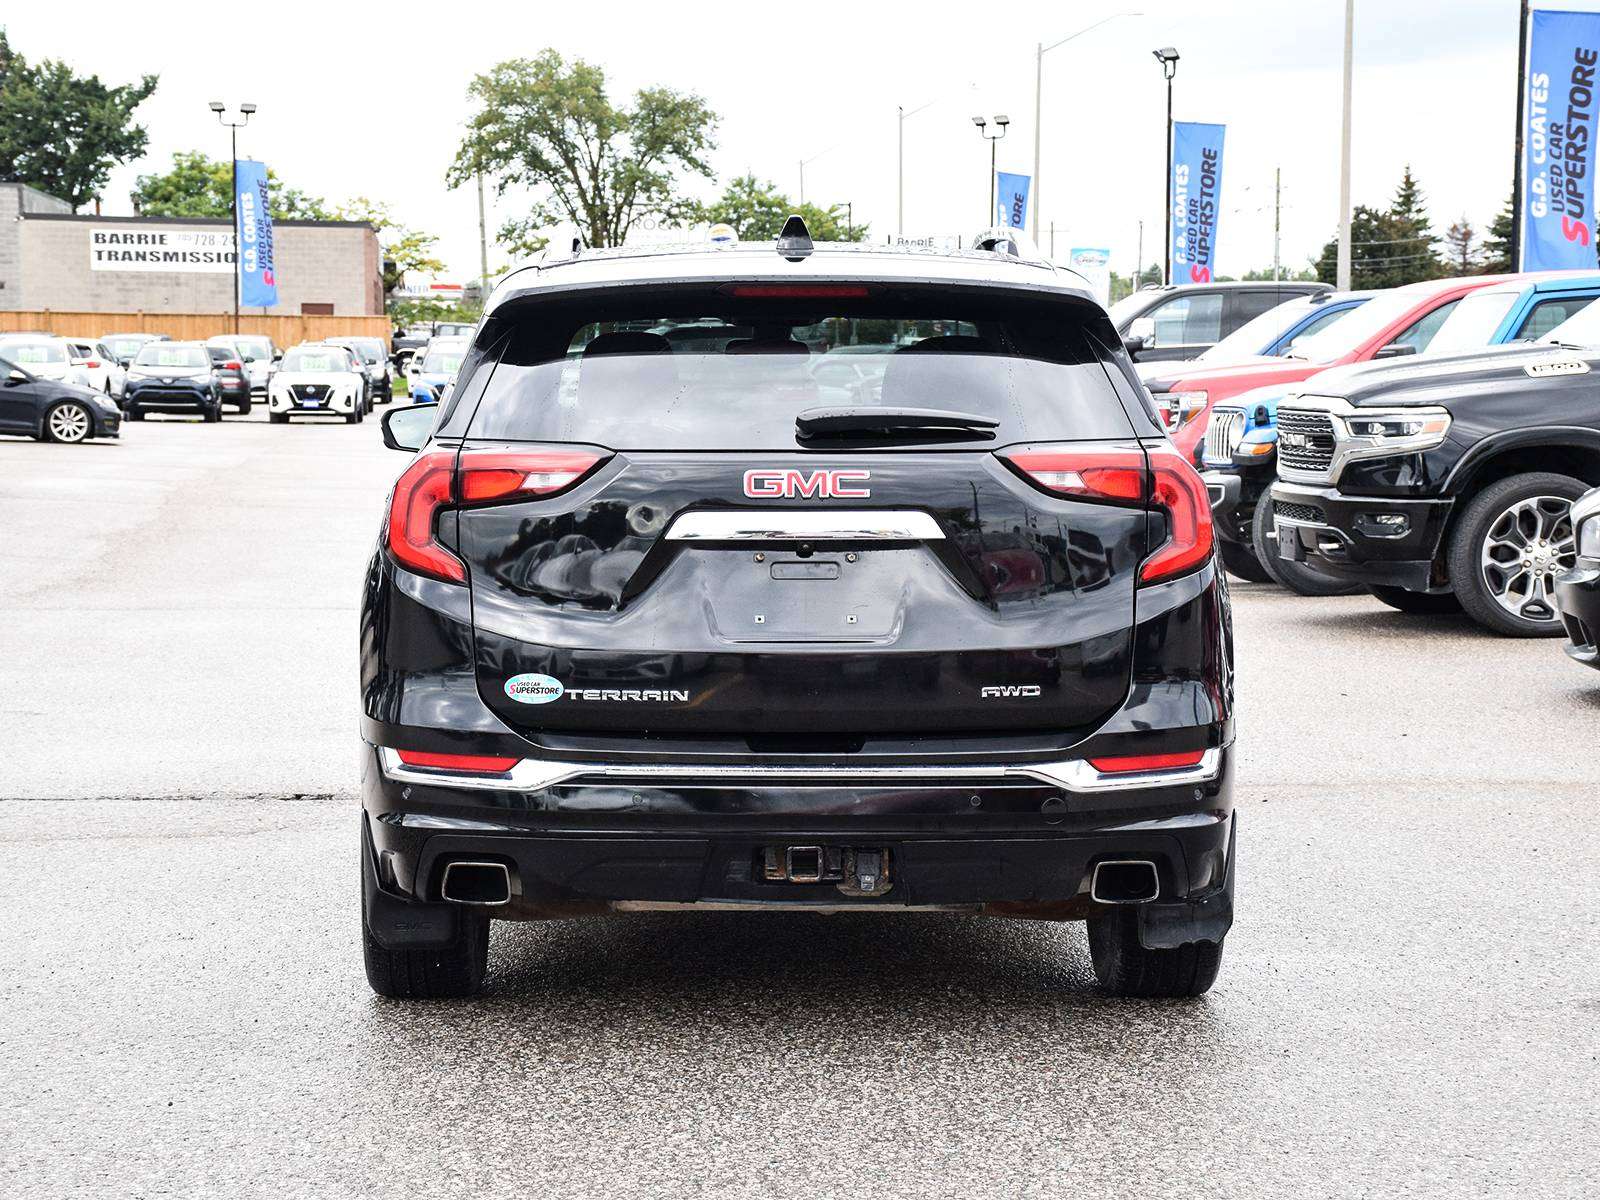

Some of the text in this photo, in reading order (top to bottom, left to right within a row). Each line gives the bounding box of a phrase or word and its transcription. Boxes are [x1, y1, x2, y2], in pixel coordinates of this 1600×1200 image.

[1531, 72, 1549, 219] G.D. COATES
[1550, 122, 1565, 213] USED CAR
[1562, 47, 1598, 246] SUPERSTORE
[241, 192, 256, 243] COATES
[1175, 164, 1189, 228] COATES
[1190, 147, 1217, 283] SUPERSTORE
[94, 233, 169, 245] BARRIE
[257, 219, 267, 269] USED CAR
[1187, 198, 1199, 262] USED CAR
[743, 469, 871, 499] GMC
[510, 684, 560, 695] SUPERSTORE
[565, 688, 689, 702] TERRAIN
[982, 685, 1041, 698] AWD
